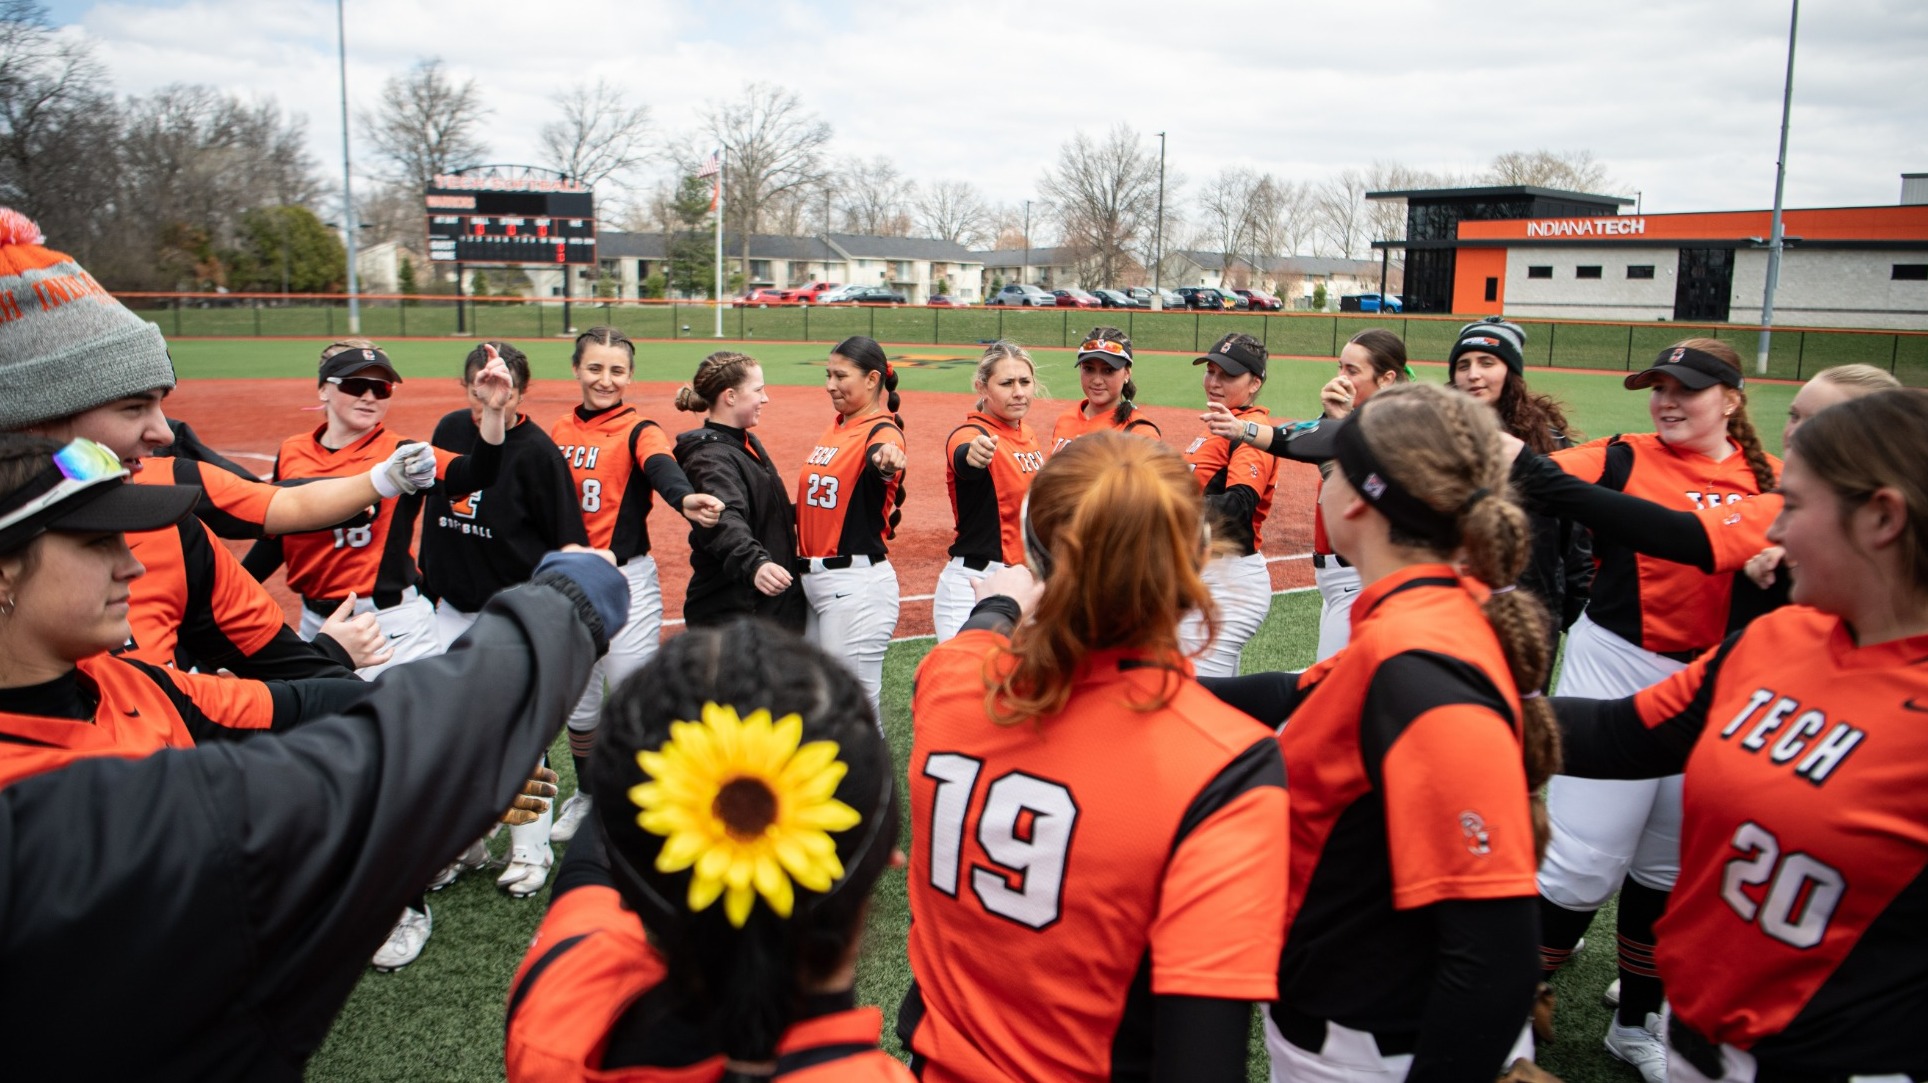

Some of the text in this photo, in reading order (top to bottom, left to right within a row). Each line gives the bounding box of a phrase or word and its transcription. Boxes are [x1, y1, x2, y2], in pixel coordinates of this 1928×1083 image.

[433, 174, 485, 190] TECH
[1527, 218, 1646, 236] INDIANA TECH
[581, 478, 602, 513] 8
[806, 472, 840, 510] 23
[1720, 688, 1866, 787] TECH
[922, 751, 1080, 933] 19
[1720, 820, 1848, 951] 20
